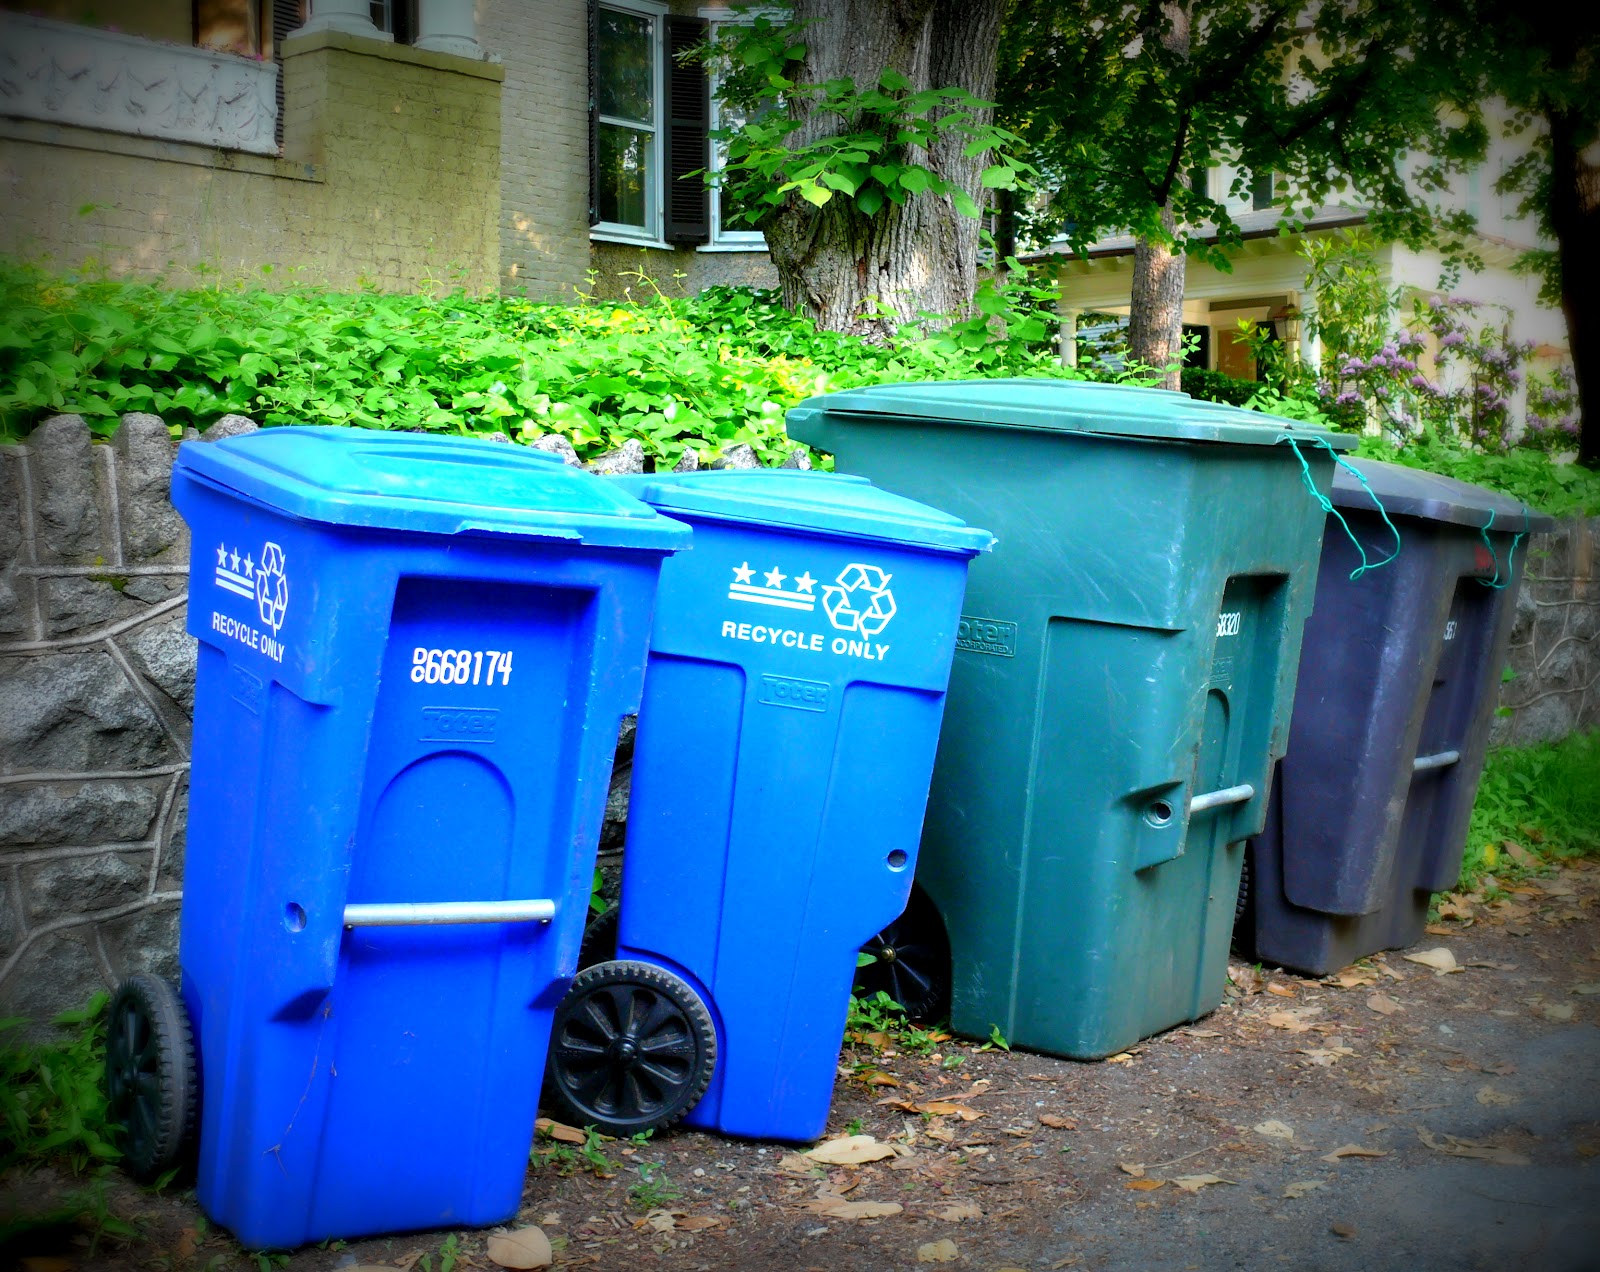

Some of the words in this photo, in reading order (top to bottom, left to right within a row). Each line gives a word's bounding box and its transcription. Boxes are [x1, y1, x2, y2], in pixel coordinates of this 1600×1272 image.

[212, 611, 259, 650] RECYCLE
[261, 635, 286, 663] ONLY
[722, 621, 825, 652] RECYCLE
[831, 638, 890, 661] ONLY
[955, 620, 1011, 645] oter
[955, 639, 1009, 654] NCORPORATED
